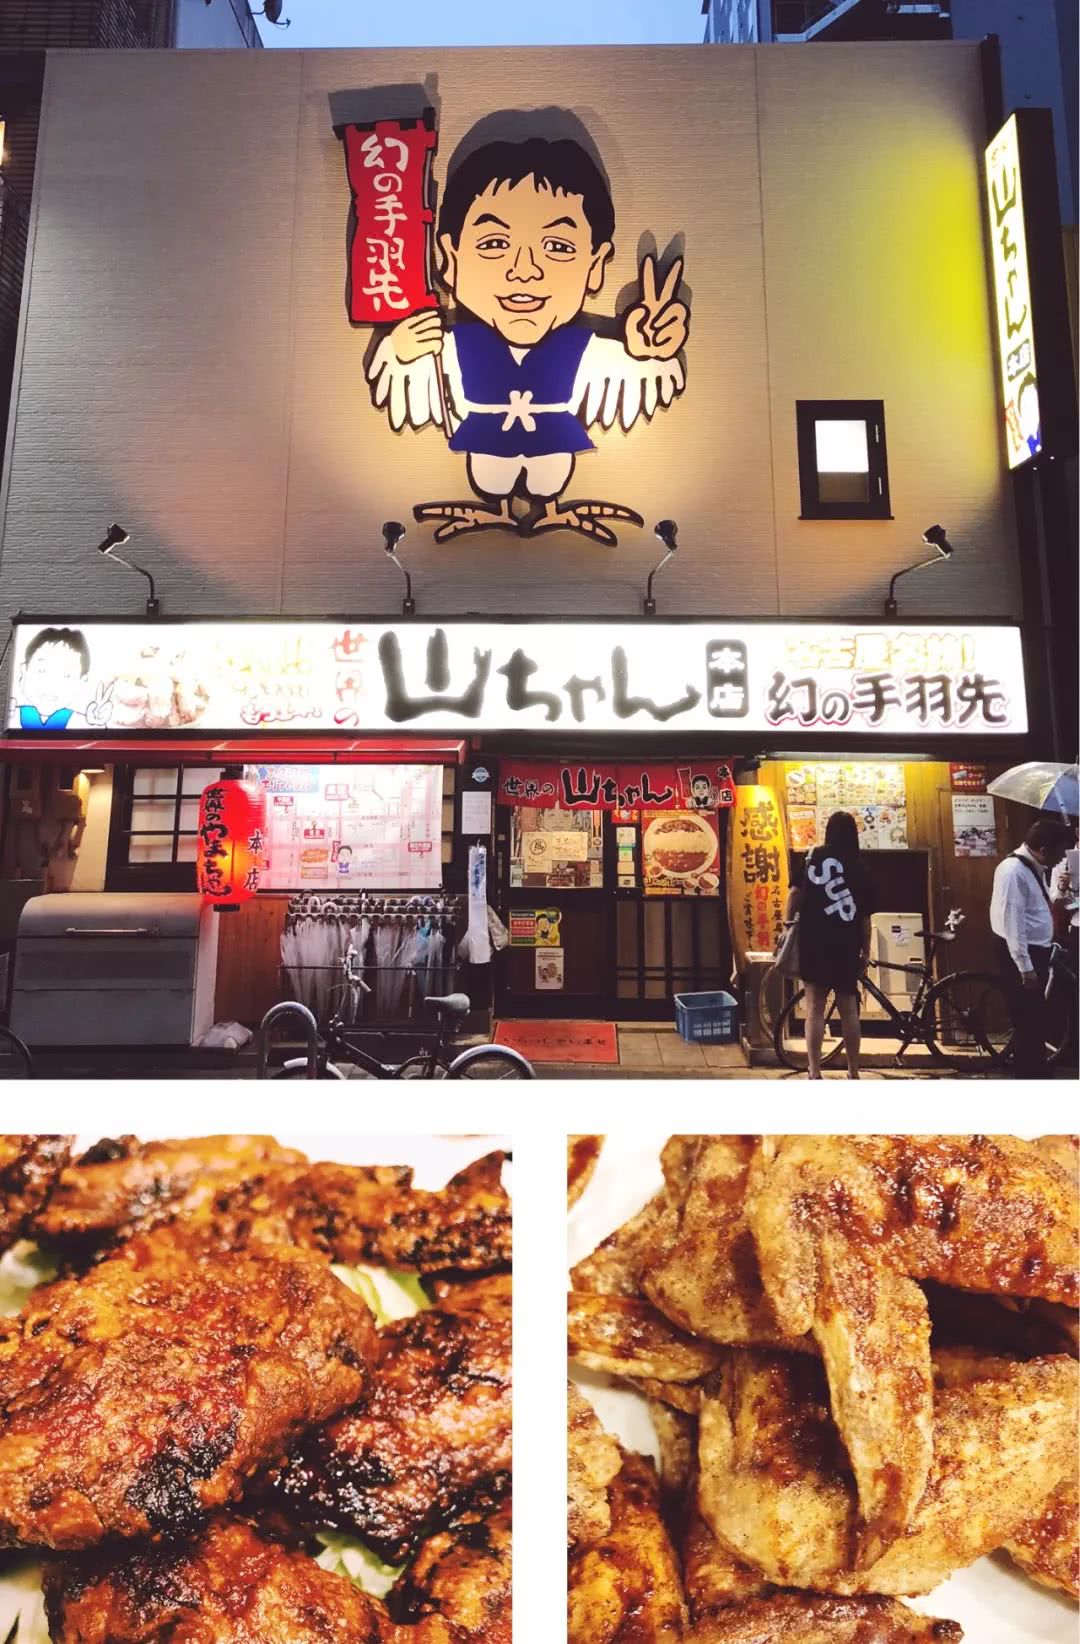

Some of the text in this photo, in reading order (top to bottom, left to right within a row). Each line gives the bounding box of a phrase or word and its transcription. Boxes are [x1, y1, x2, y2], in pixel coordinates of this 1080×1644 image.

[360, 133, 410, 312] 幻の手羽先
[378, 627, 702, 724] 山ちゃん
[709, 646, 746, 711] 本店
[767, 671, 1009, 726] 幻の手羽先
[740, 800, 781, 883] 感謝
[808, 857, 857, 922] SUP
